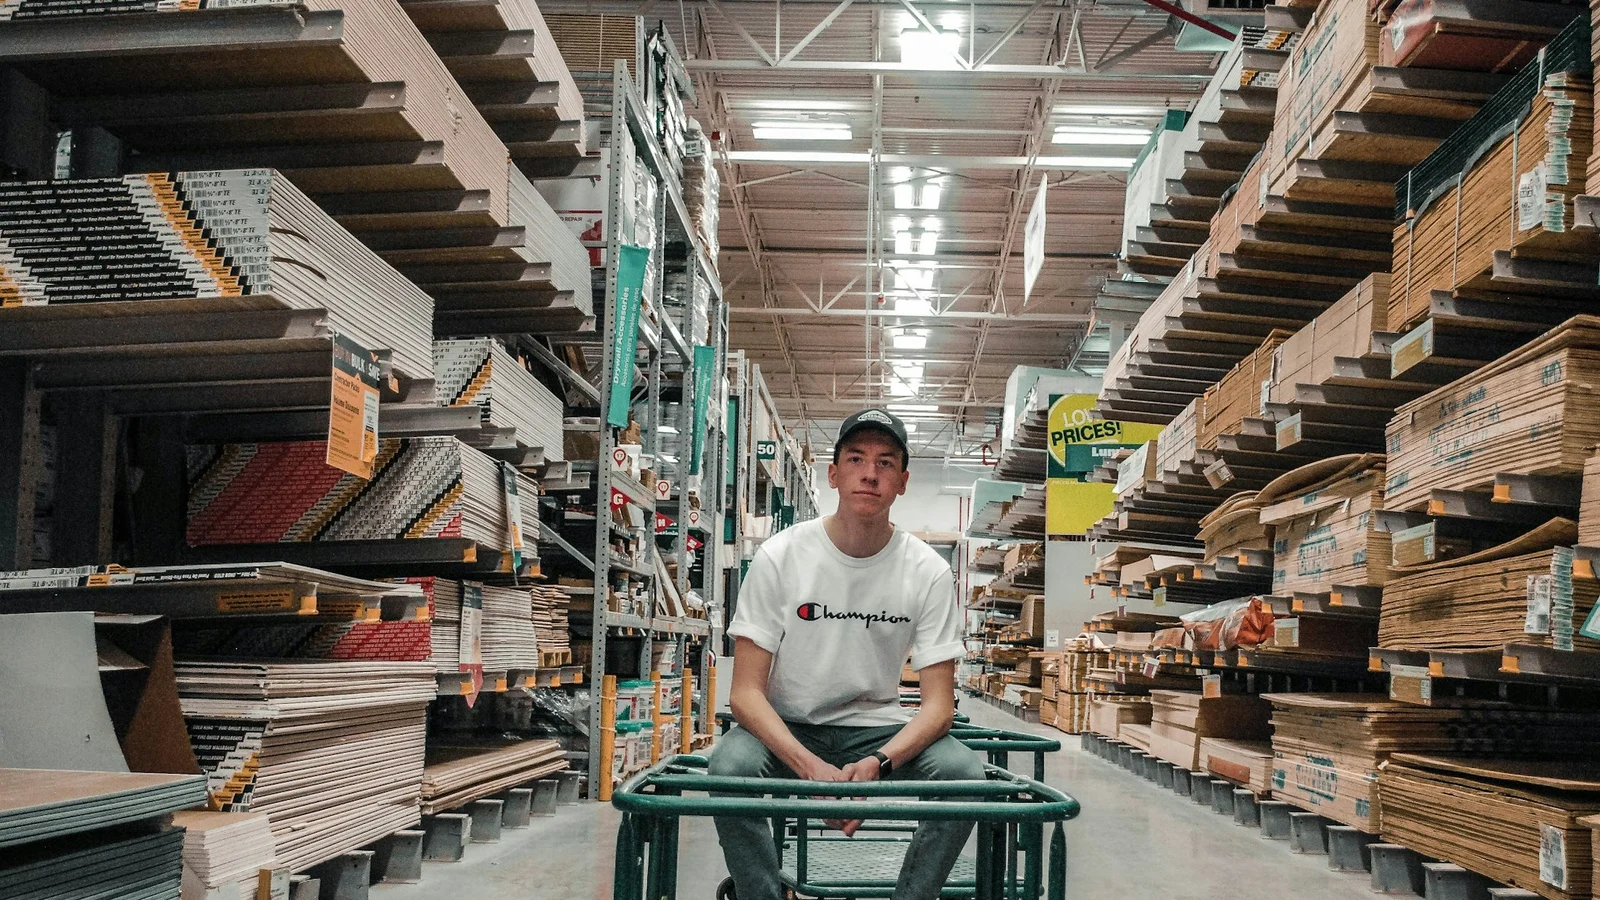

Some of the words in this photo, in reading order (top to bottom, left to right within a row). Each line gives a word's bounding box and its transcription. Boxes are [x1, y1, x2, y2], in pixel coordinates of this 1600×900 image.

[617, 286, 629, 344] Accessories
[352, 353, 365, 373] BULK
[613, 344, 622, 384] Drywall
[1051, 421, 1122, 446] PRICES!
[758, 444, 774, 454] 50
[613, 494, 623, 505] G
[797, 602, 911, 628] Champion
